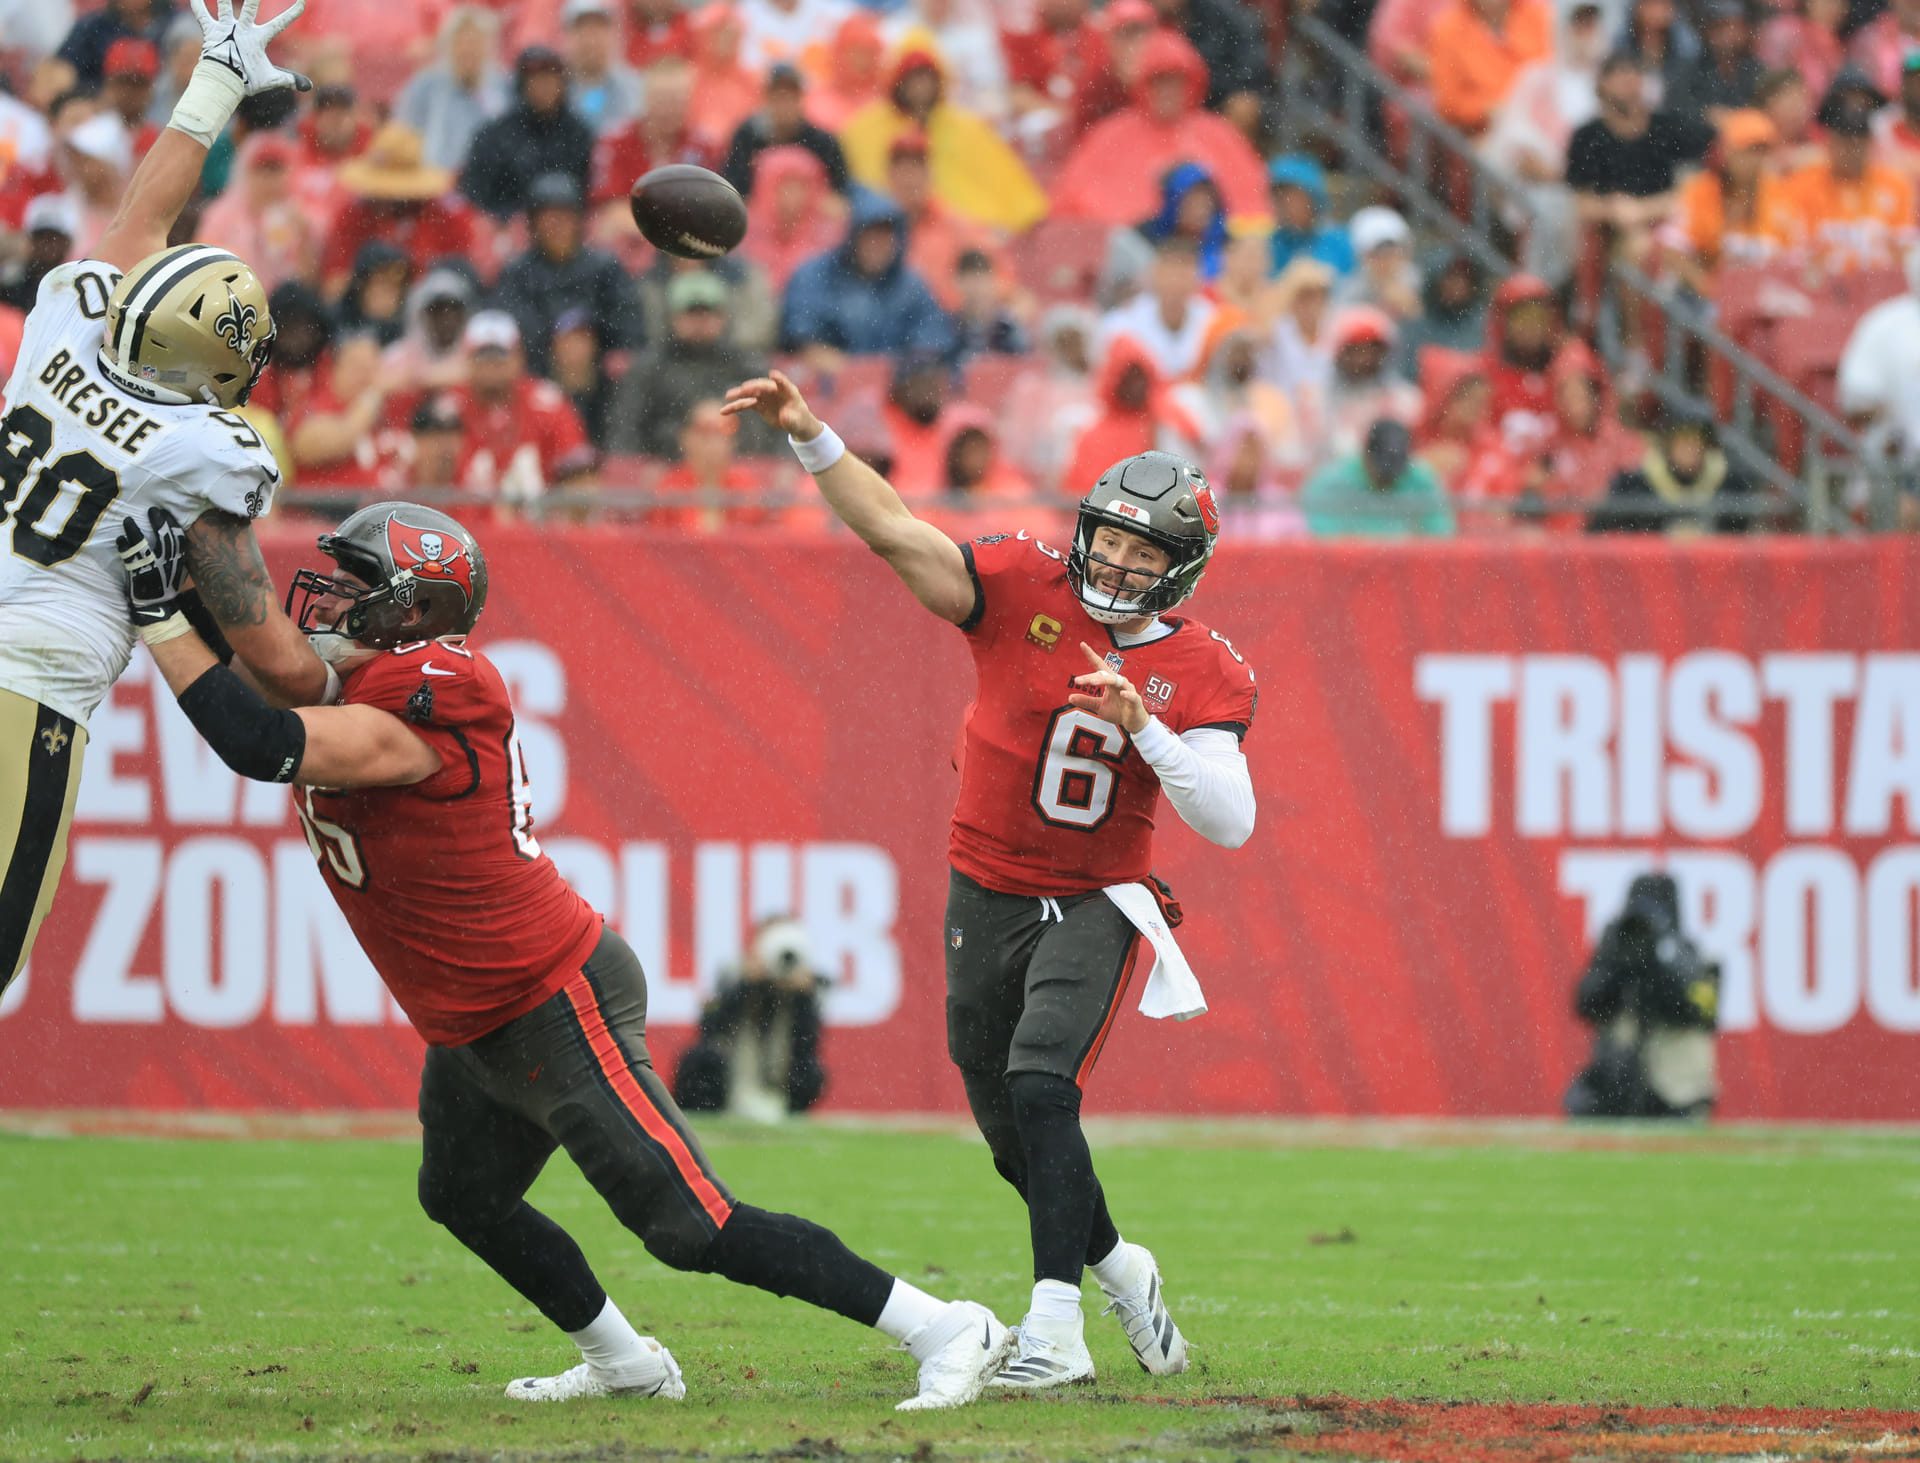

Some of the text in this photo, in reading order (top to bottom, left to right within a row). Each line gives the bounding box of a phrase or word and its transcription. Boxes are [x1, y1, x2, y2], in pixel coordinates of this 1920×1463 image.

[40, 349, 163, 456] BRESEE
[1030, 614, 1062, 643] C
[1146, 676, 1172, 700] 50
[72, 640, 567, 826] EVS
[1033, 706, 1129, 831] 6
[1413, 649, 1920, 839] TRISTA
[72, 837, 412, 1028] ZON
